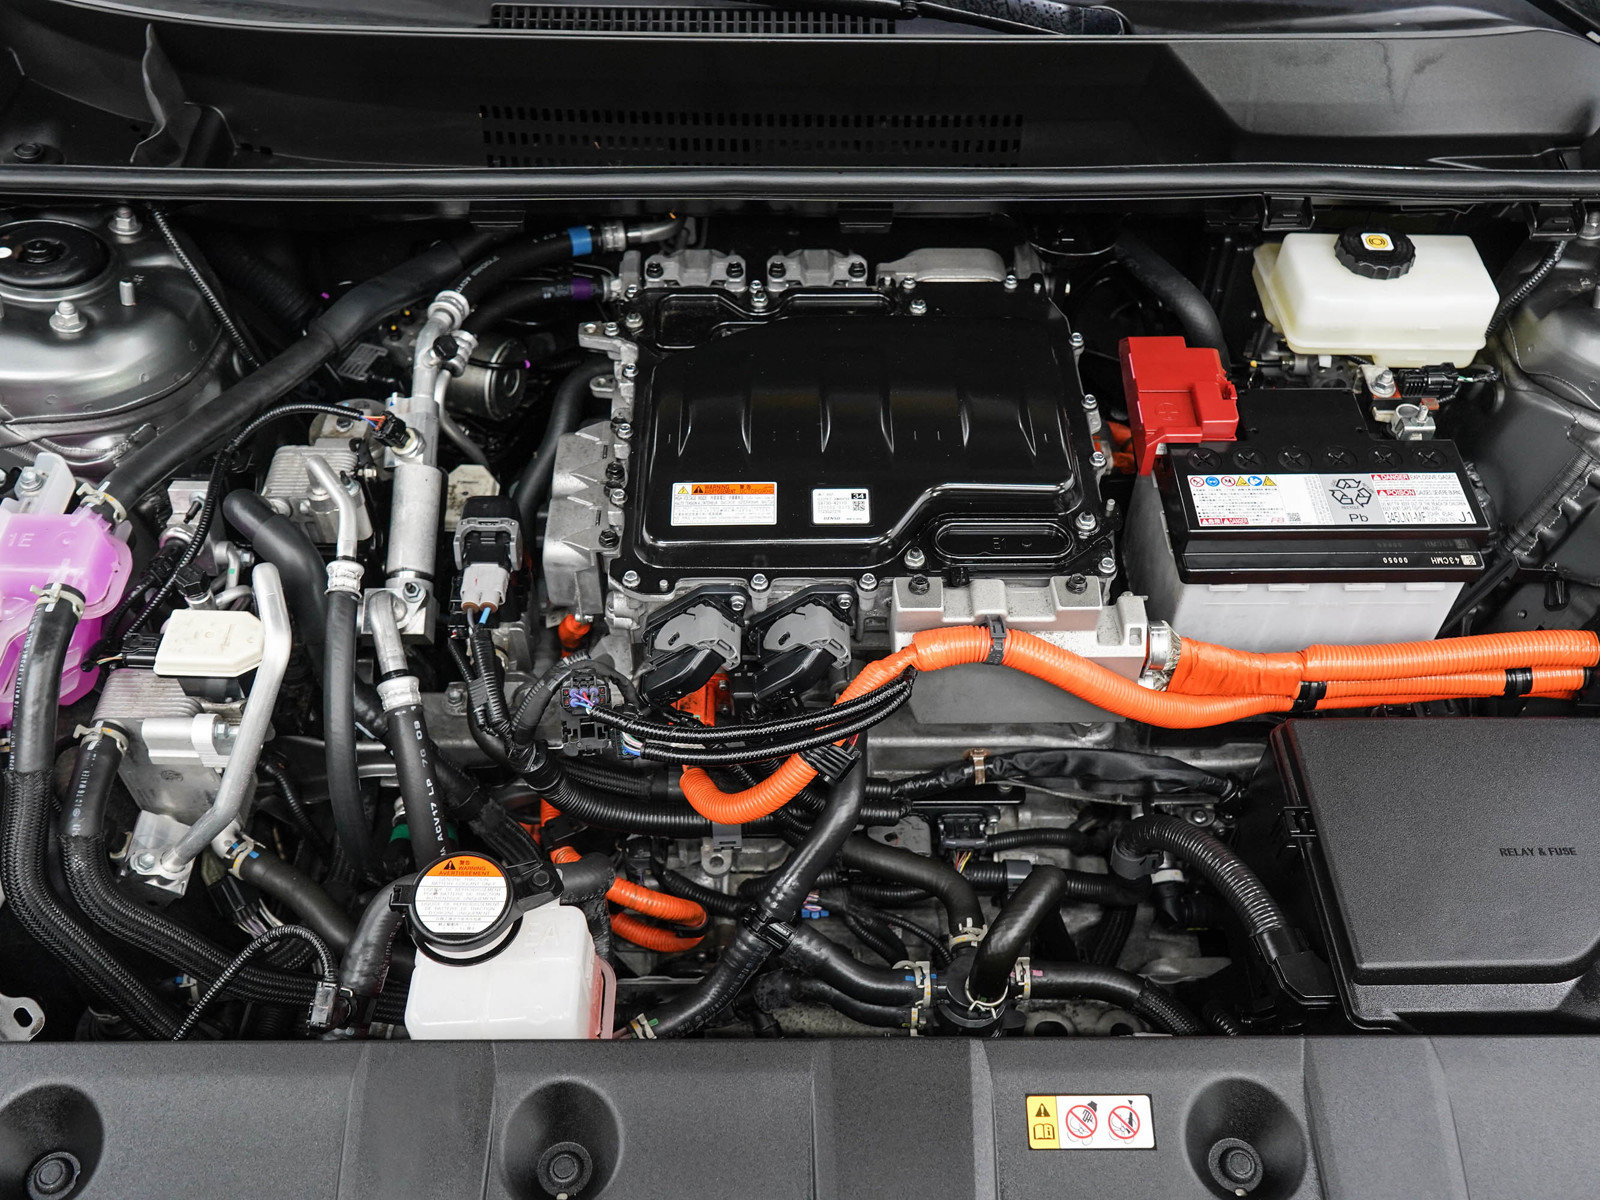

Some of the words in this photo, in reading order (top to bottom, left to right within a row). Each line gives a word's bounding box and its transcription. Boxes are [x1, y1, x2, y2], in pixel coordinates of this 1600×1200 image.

[1349, 514, 1369, 522] Pb
[1458, 511, 1475, 523] J1
[426, 778, 435, 796] LP
[430, 802, 444, 841] ACV17
[1499, 846, 1535, 857] RELAY
[1538, 846, 1547, 857] &
[1548, 846, 1578, 856] FUSE
